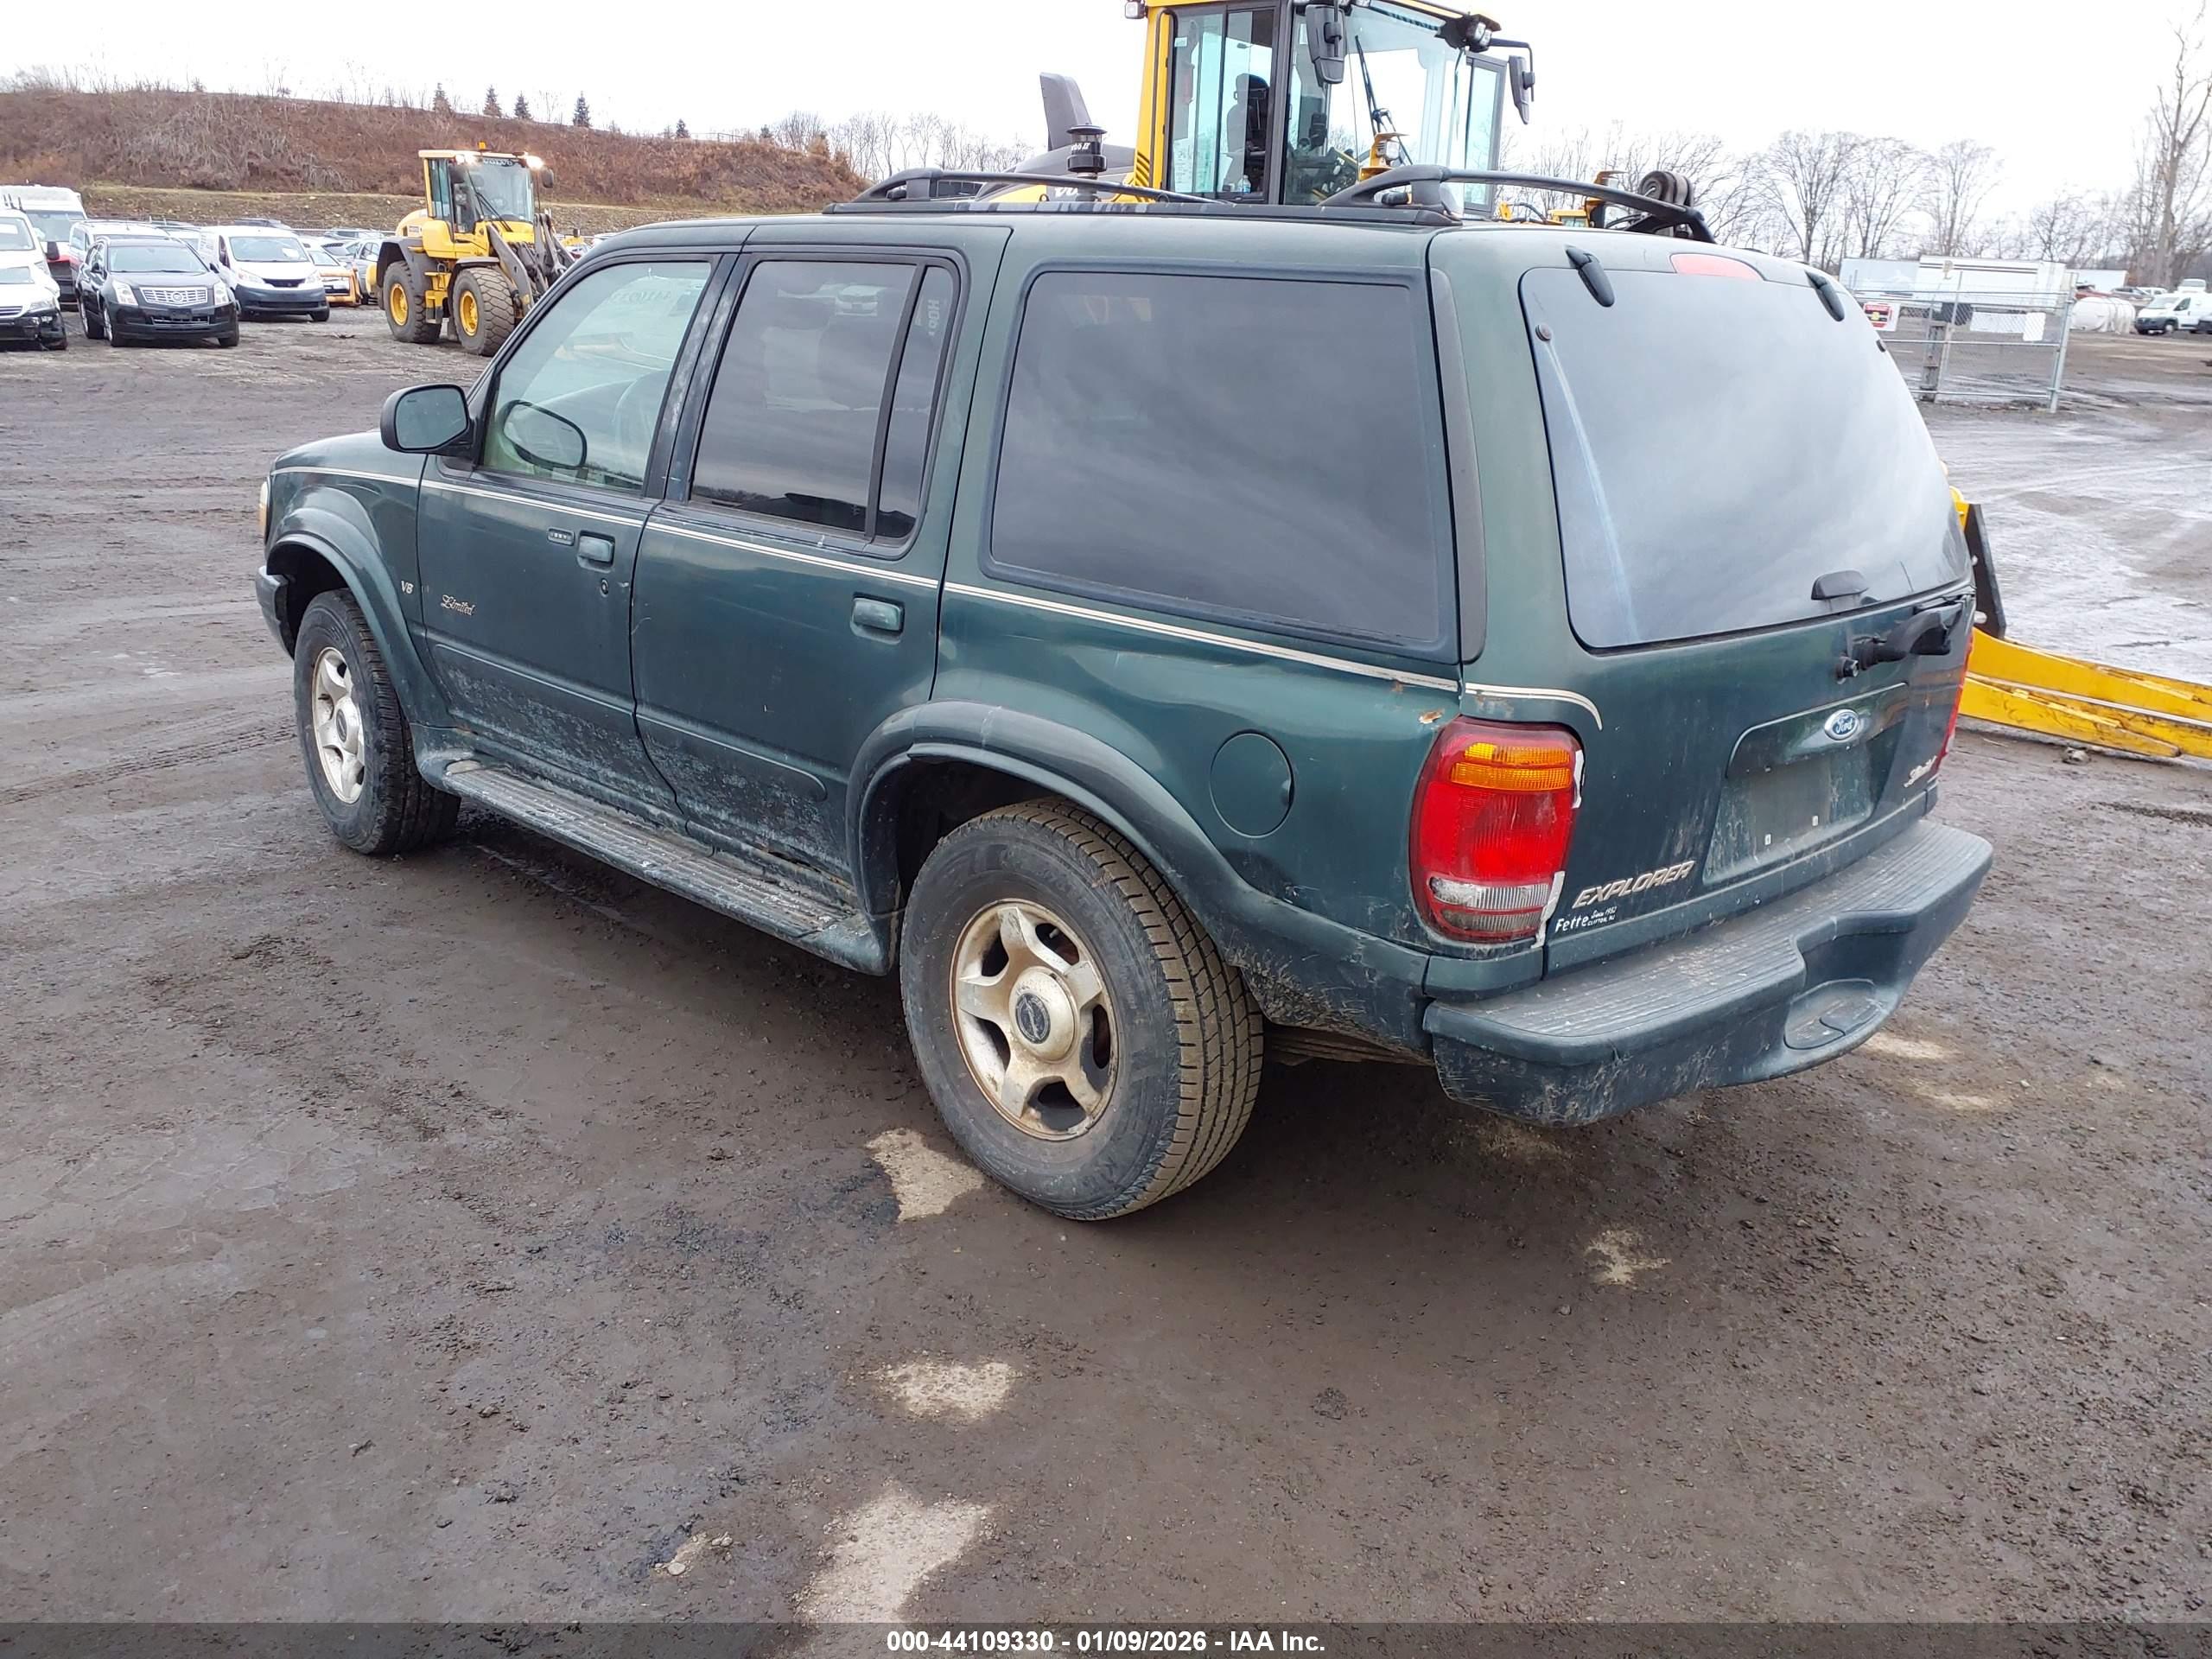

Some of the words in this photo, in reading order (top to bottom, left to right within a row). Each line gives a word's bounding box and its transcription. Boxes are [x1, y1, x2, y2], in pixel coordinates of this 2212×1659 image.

[401, 580, 414, 594] V8
[441, 594, 475, 616] Limited
[1833, 714, 1855, 734] Ford
[1571, 860, 1696, 909] EXPLORER
[1554, 915, 1589, 933] Fette
